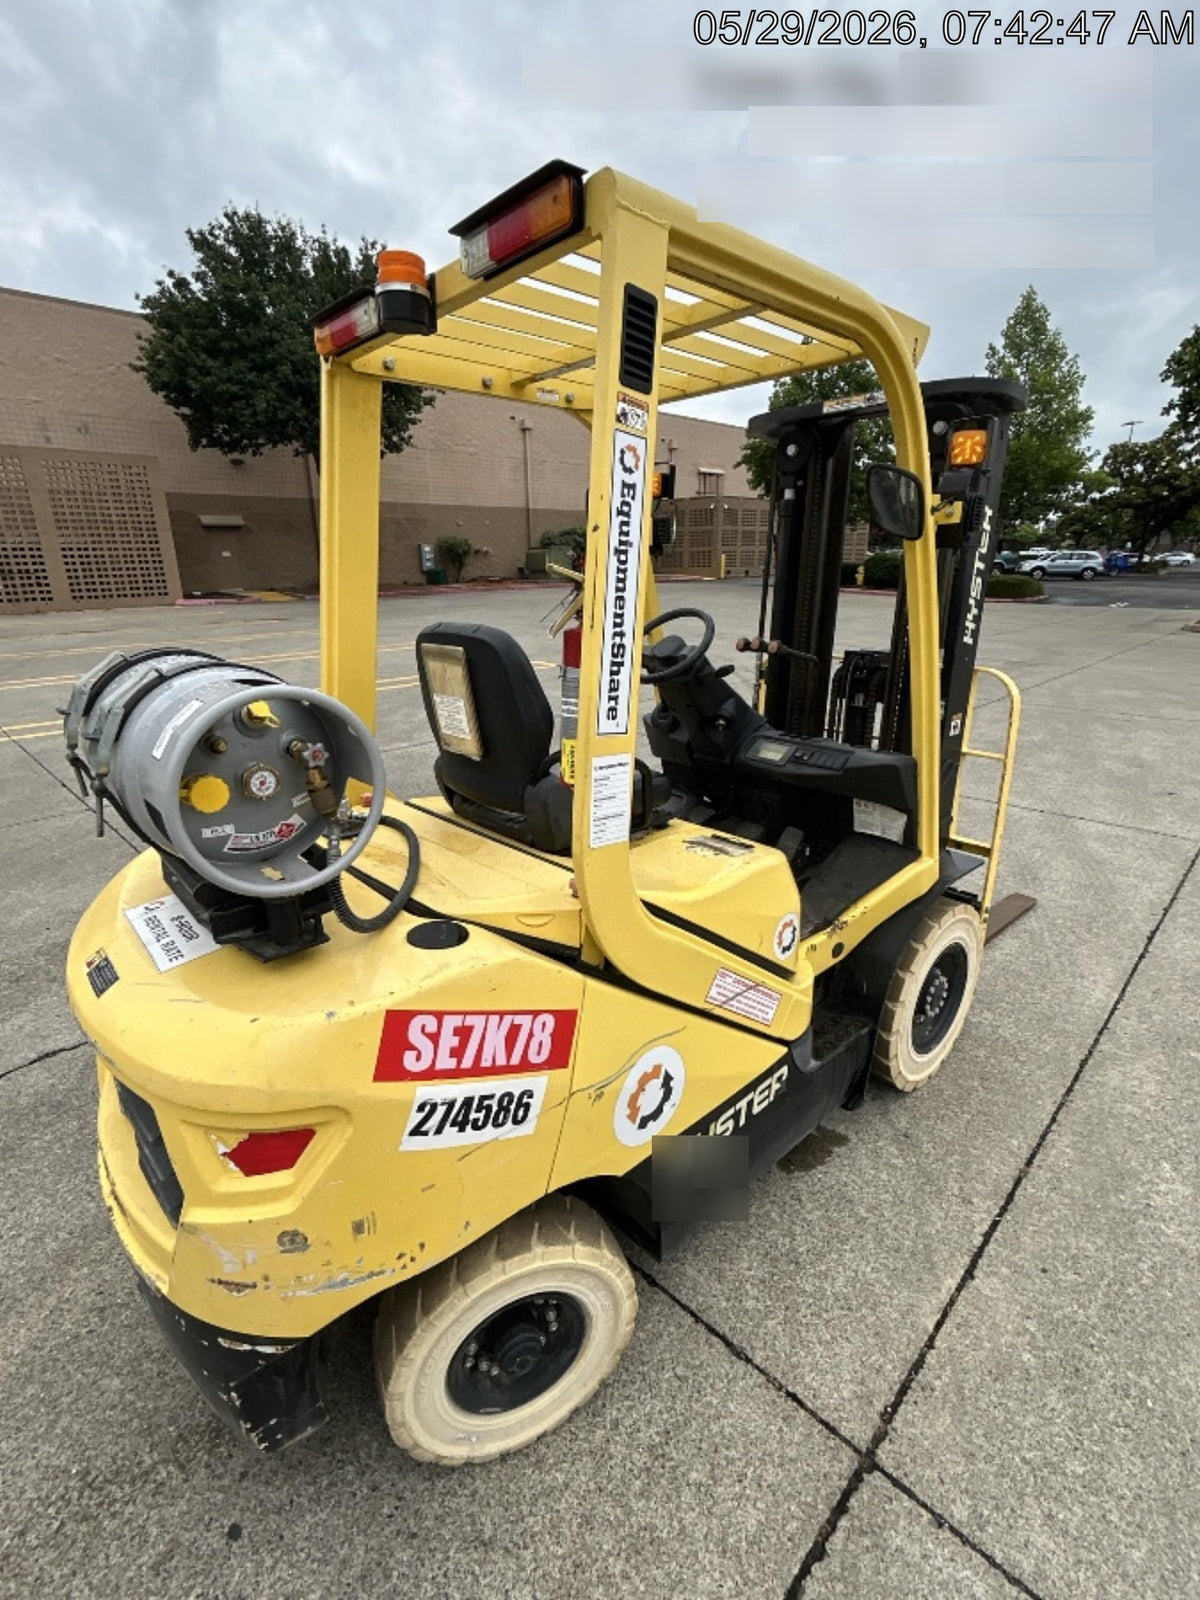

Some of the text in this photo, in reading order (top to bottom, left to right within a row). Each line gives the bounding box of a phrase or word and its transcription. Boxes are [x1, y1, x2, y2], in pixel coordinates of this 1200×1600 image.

[606, 480, 637, 722] EquipmentShare
[963, 505, 993, 645] HYSTER
[160, 939, 185, 963] RATE
[402, 1013, 555, 1073] SE7K78
[408, 1089, 534, 1137] 274586
